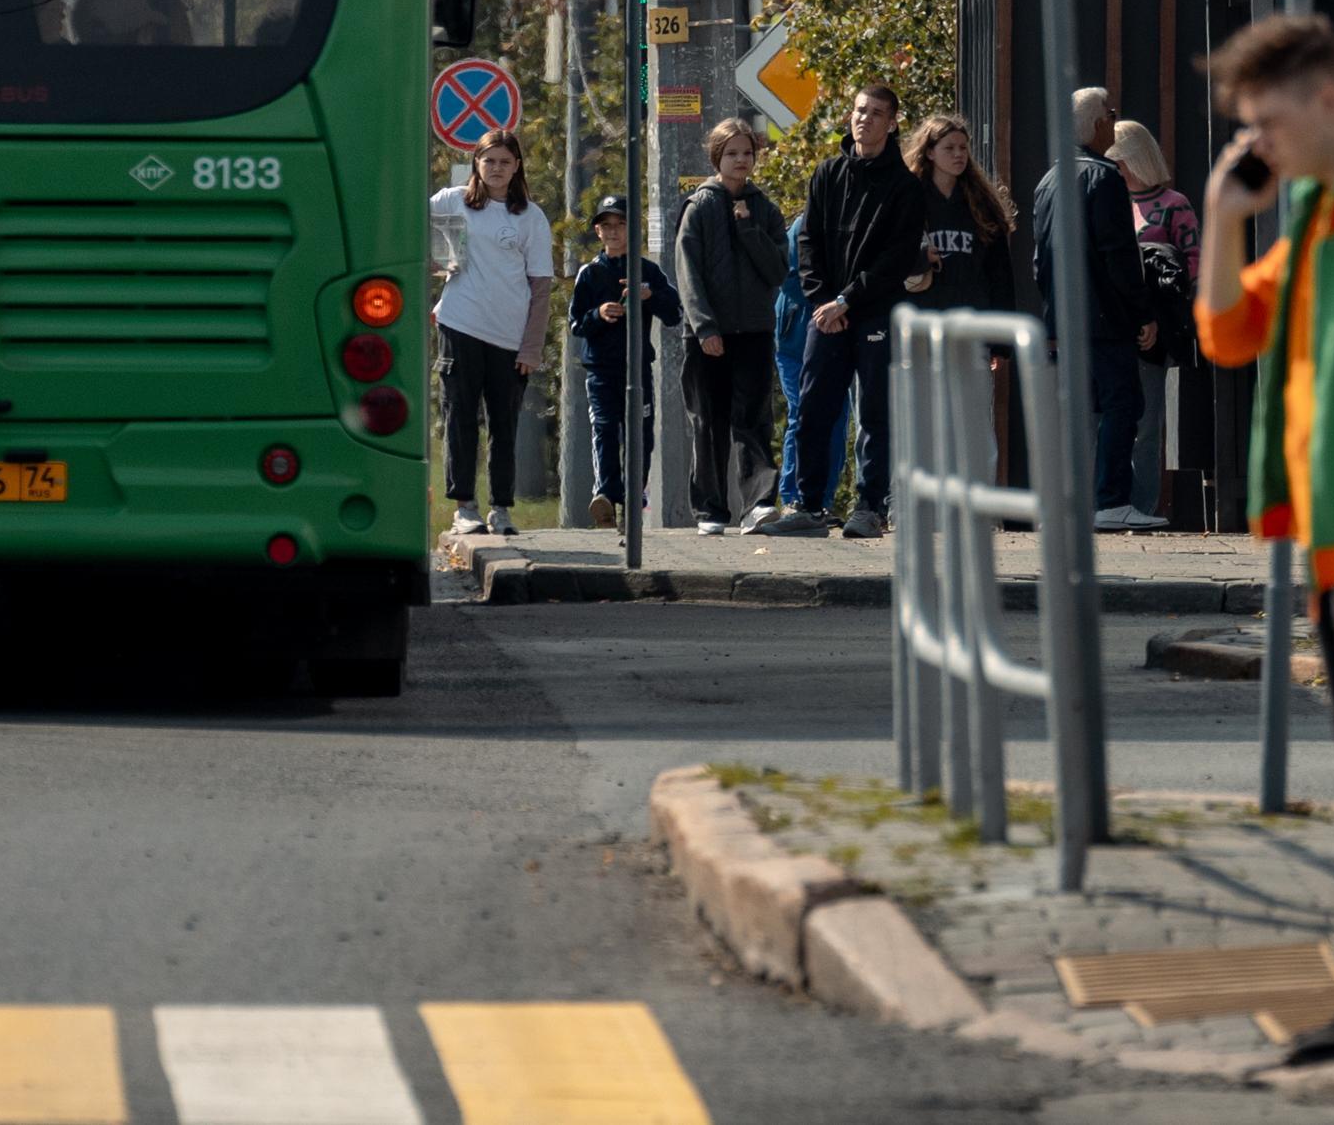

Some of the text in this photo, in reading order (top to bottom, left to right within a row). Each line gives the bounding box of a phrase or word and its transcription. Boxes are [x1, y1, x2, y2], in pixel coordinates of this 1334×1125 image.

[655, 16, 680, 35] 326
[193, 156, 281, 190] 8133
[25, 466, 56, 488] 74
[28, 489, 50, 498] RUS
